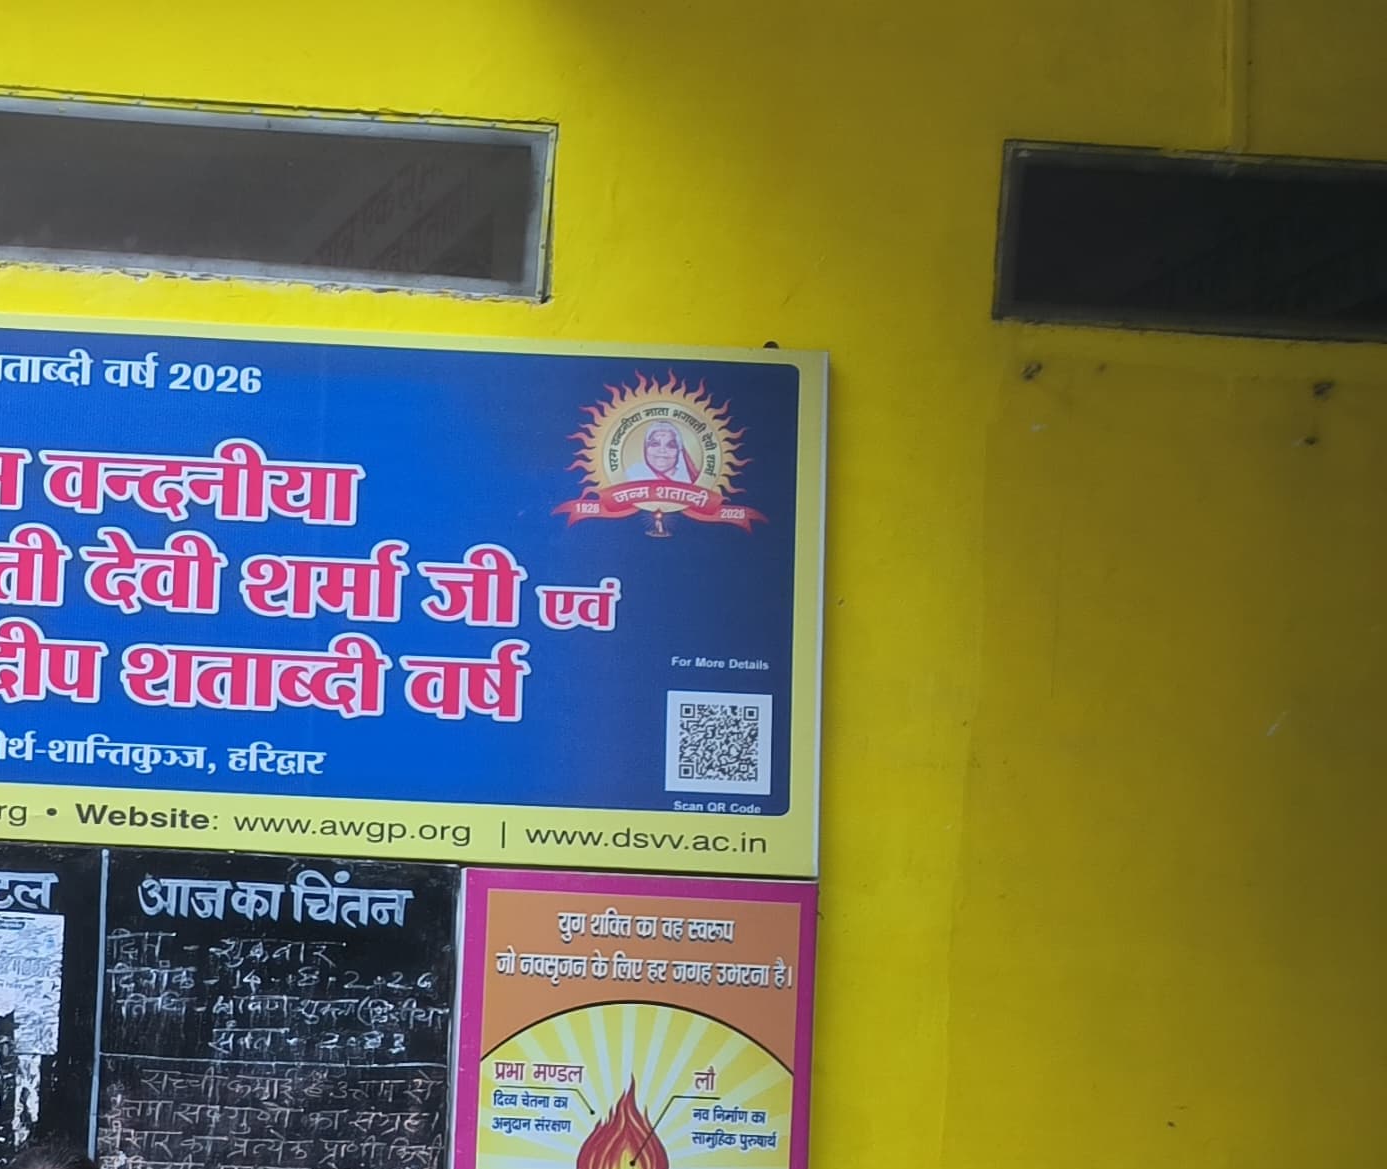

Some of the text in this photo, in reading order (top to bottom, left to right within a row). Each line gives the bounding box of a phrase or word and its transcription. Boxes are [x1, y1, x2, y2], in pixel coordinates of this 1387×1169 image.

[103, 353, 158, 390] वर्ष
[169, 363, 262, 394] 2026
[39, 440, 365, 526] वन्दनीया
[612, 487, 650, 504] जन्म
[79, 529, 228, 616] देवी
[240, 539, 410, 622] शर्मा
[417, 544, 527, 628] जी
[535, 578, 621, 632] एवं
[121, 633, 390, 720] शताब्दी
[400, 639, 532, 721] वर्ष
[671, 656, 769, 670] For More Details
[227, 740, 327, 777] हरिद्वार
[674, 801, 761, 814] Scan QR Code
[75, 803, 219, 832] Website:
[233, 812, 472, 847] www.awgp.org
[526, 823, 768, 855] www.dsvv.ac.in
[137, 869, 415, 929] आज का चिंतन
[558, 907, 735, 942] युग शक्ति का वह स्वरूप
[495, 945, 516, 976] जो
[520, 952, 588, 985] नवसृजन
[591, 949, 609, 979] के
[612, 951, 645, 981] लिए
[647, 958, 669, 982] हर
[672, 960, 712, 985] जगह
[716, 962, 770, 987] उभरना
[494, 1062, 584, 1083] प्रभा मण्डल
[694, 1065, 717, 1091] लौ
[493, 1089, 568, 1109] दिव्य चेतना का
[692, 1105, 766, 1123] नव निर्माण का
[492, 1116, 571, 1134] अनुदान संरक्षण
